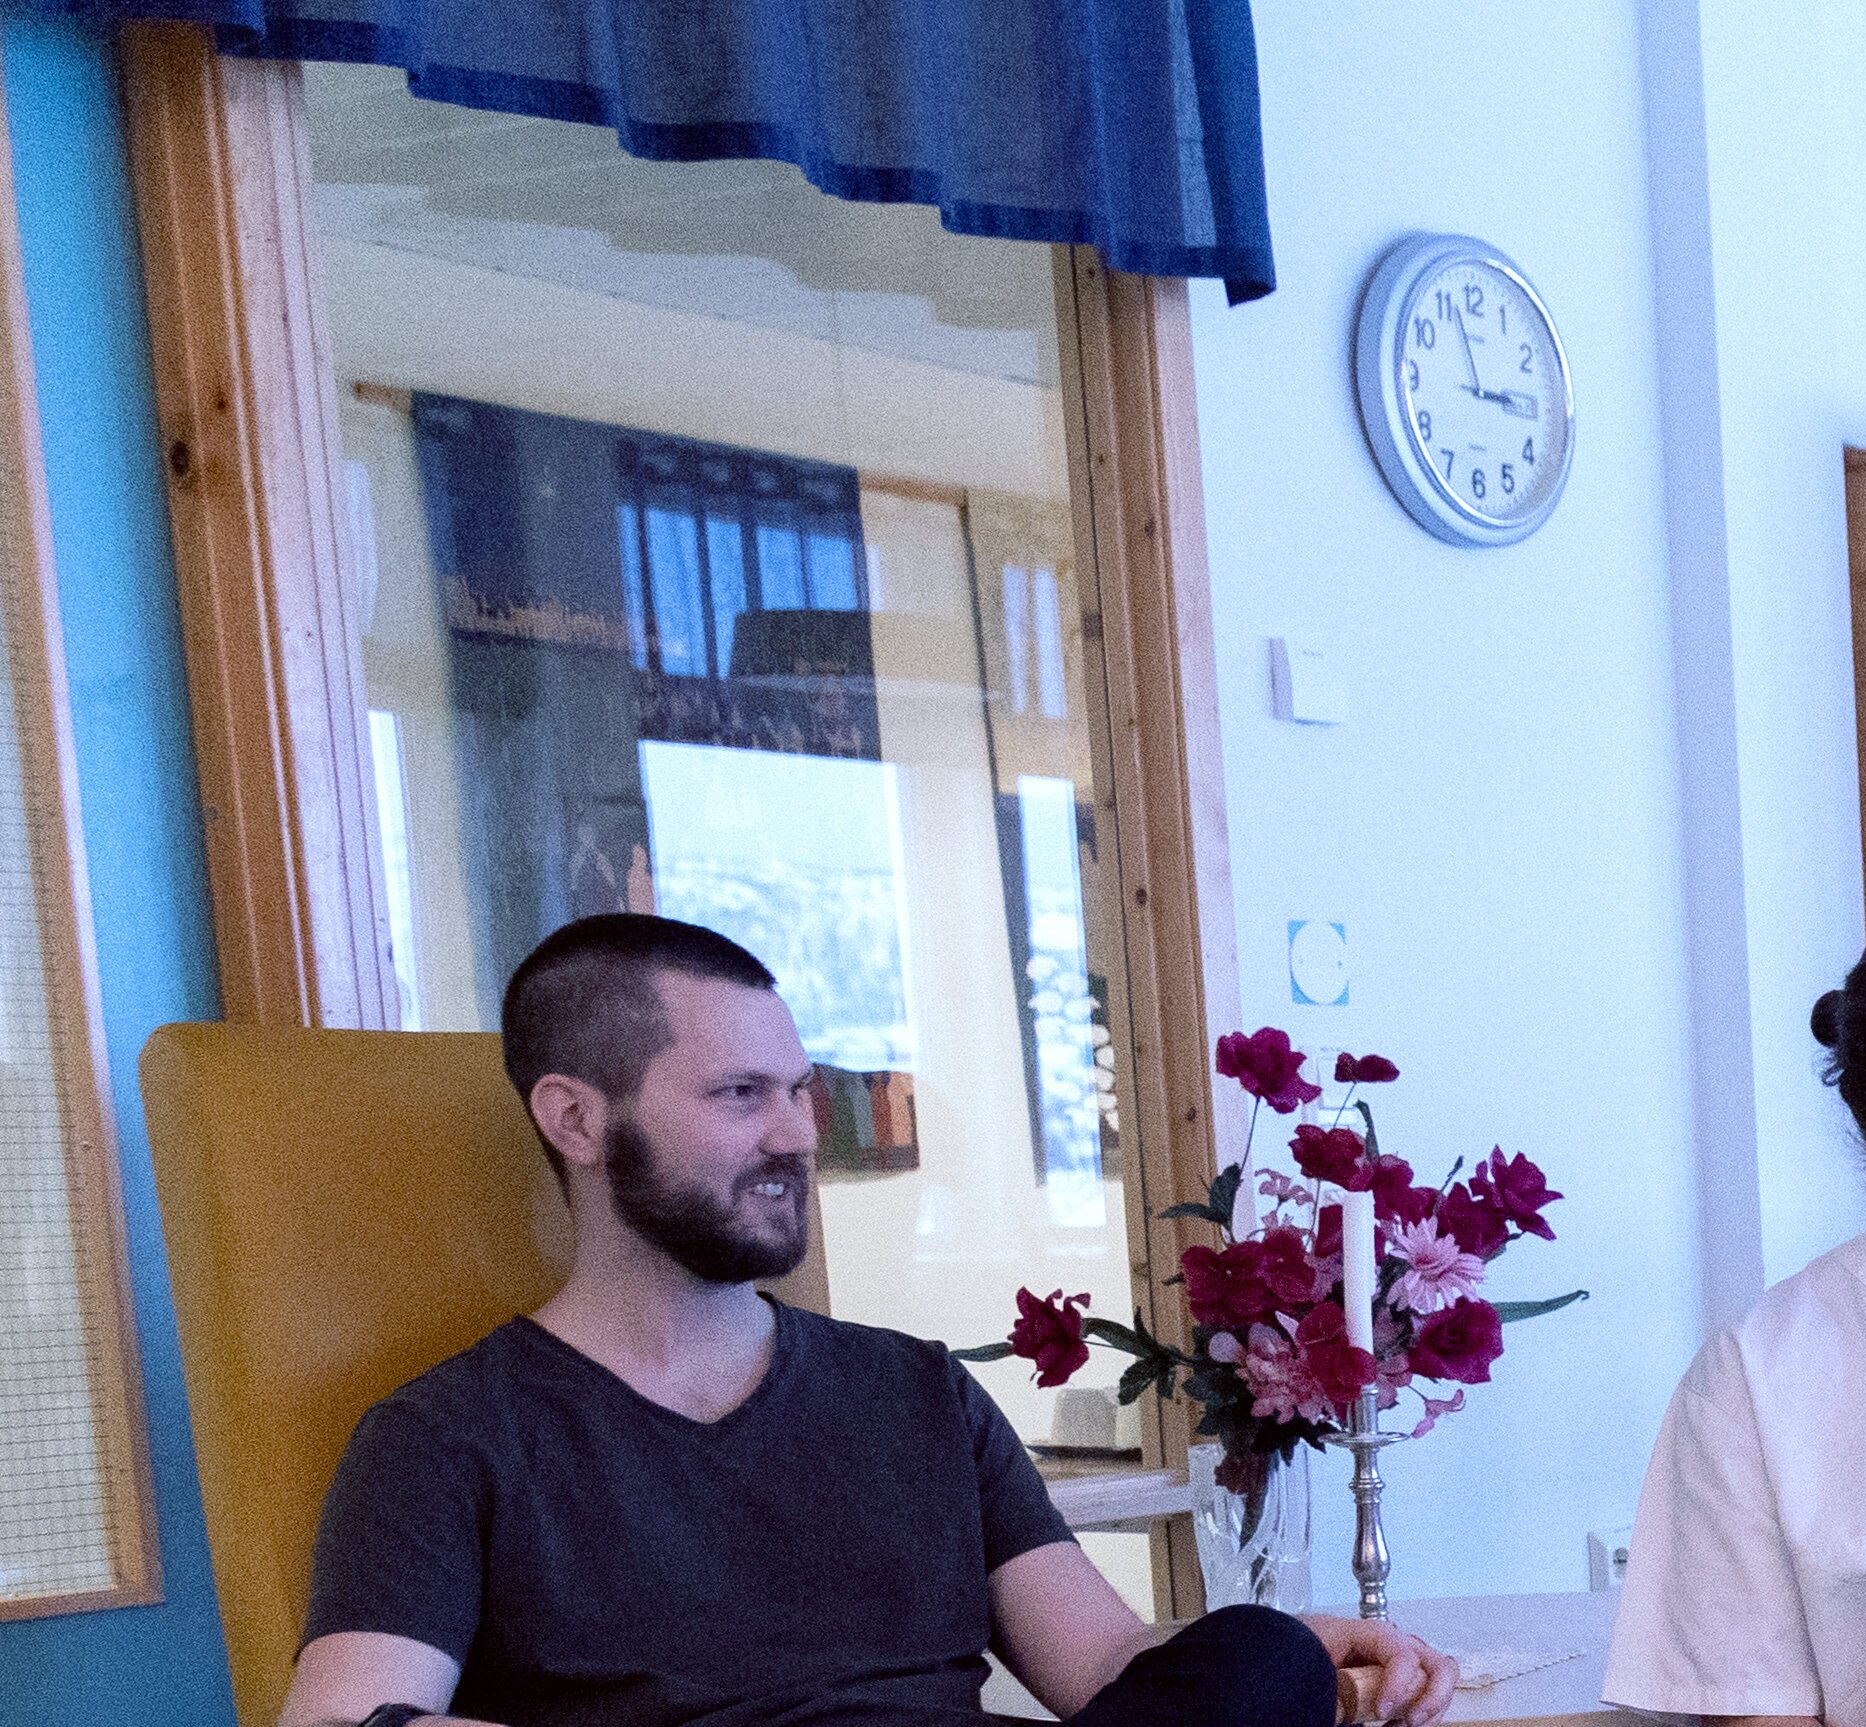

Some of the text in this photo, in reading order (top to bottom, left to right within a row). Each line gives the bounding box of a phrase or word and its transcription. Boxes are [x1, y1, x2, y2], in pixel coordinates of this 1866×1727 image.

[1436, 290, 1452, 321] 11
[1464, 284, 1484, 316] 12
[1414, 316, 1435, 349] 10
[1500, 306, 1506, 335] 1
[1520, 343, 1533, 373] 2
[1418, 411, 1431, 442] 8
[1441, 449, 1454, 481] 7
[1522, 436, 1534, 465] 4
[1472, 469, 1486, 498] 6
[1502, 464, 1514, 493] 5
